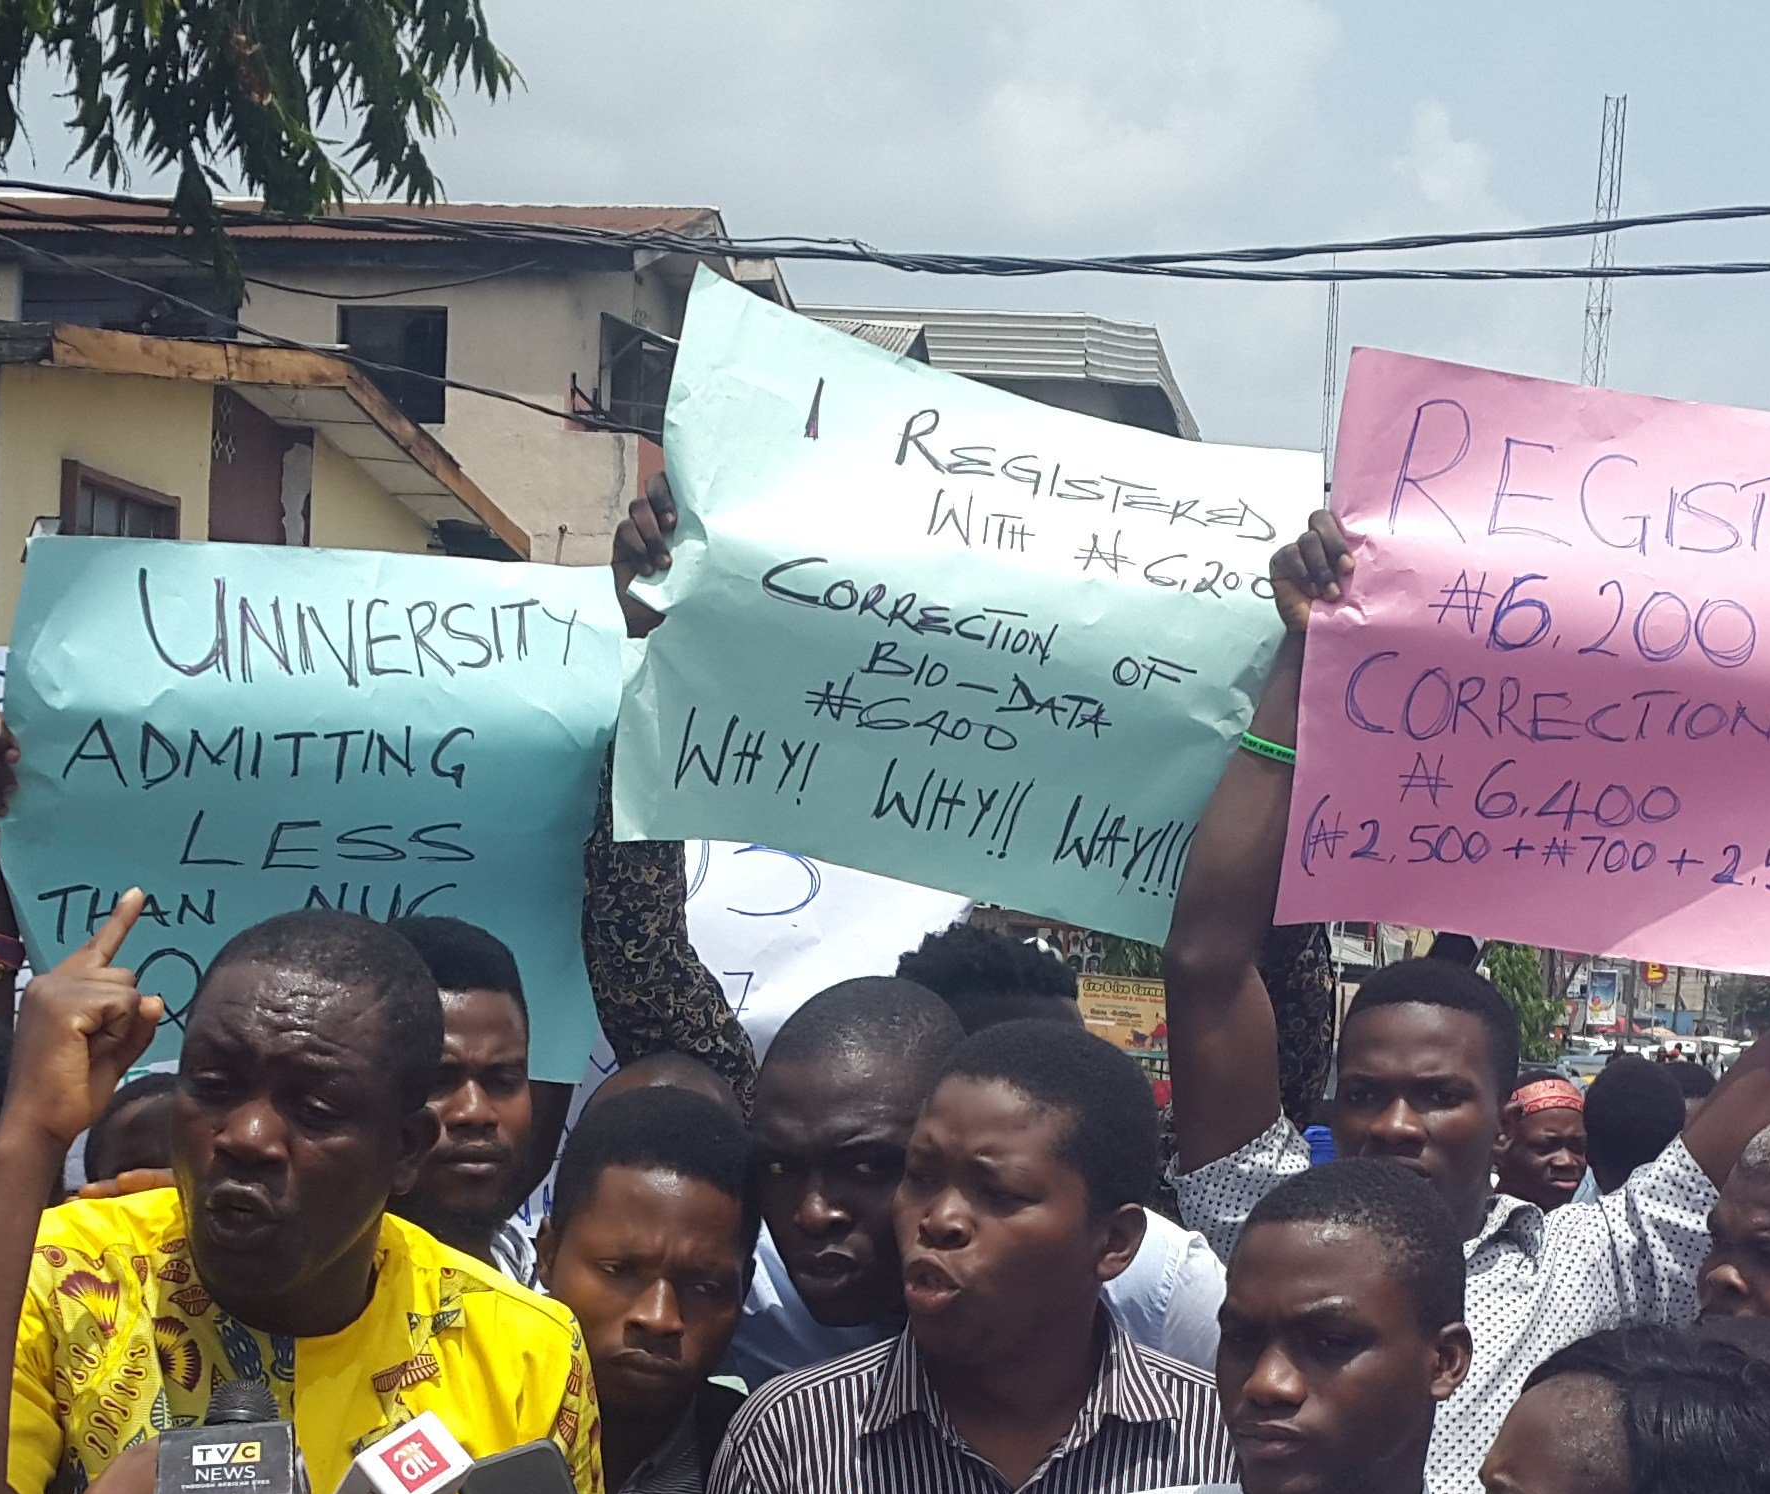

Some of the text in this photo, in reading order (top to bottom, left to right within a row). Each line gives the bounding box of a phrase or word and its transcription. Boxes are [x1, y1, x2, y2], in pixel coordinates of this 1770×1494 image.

[803, 376, 1277, 545] I REGISTERED
[927, 488, 1037, 550] WITH
[138, 567, 579, 687] UNIVERSITY
[761, 556, 1198, 691] CORRECTION OF
[61, 718, 476, 791] ADMITTING
[673, 705, 822, 806] WHY!
[872, 757, 1035, 860] WHY!!
[178, 808, 477, 870] LESS
[37, 883, 217, 945] THAN
[194, 1465, 257, 1482] NEWS
[196, 1445, 257, 1463] TVC
